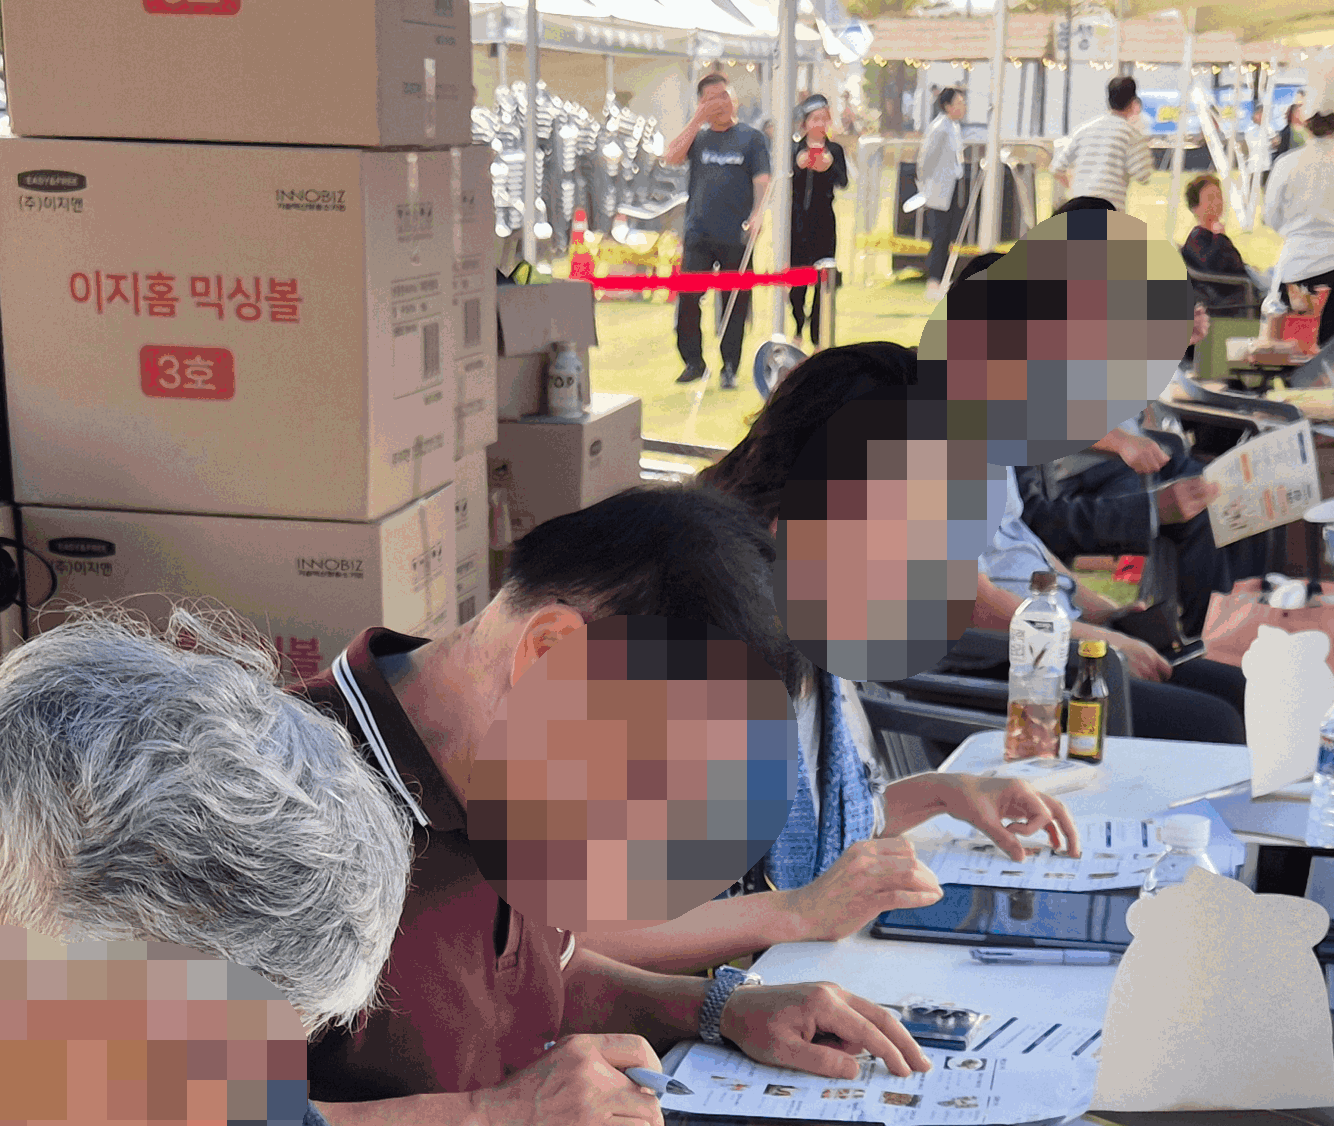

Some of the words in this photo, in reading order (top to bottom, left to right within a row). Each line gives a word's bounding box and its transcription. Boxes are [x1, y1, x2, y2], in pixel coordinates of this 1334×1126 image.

[275, 189, 346, 204] INNOBIZ
[69, 269, 179, 319] 이지홈
[190, 274, 304, 324] 믹싱볼
[157, 355, 217, 390] 3호
[297, 558, 363, 572] INNOBIZ
